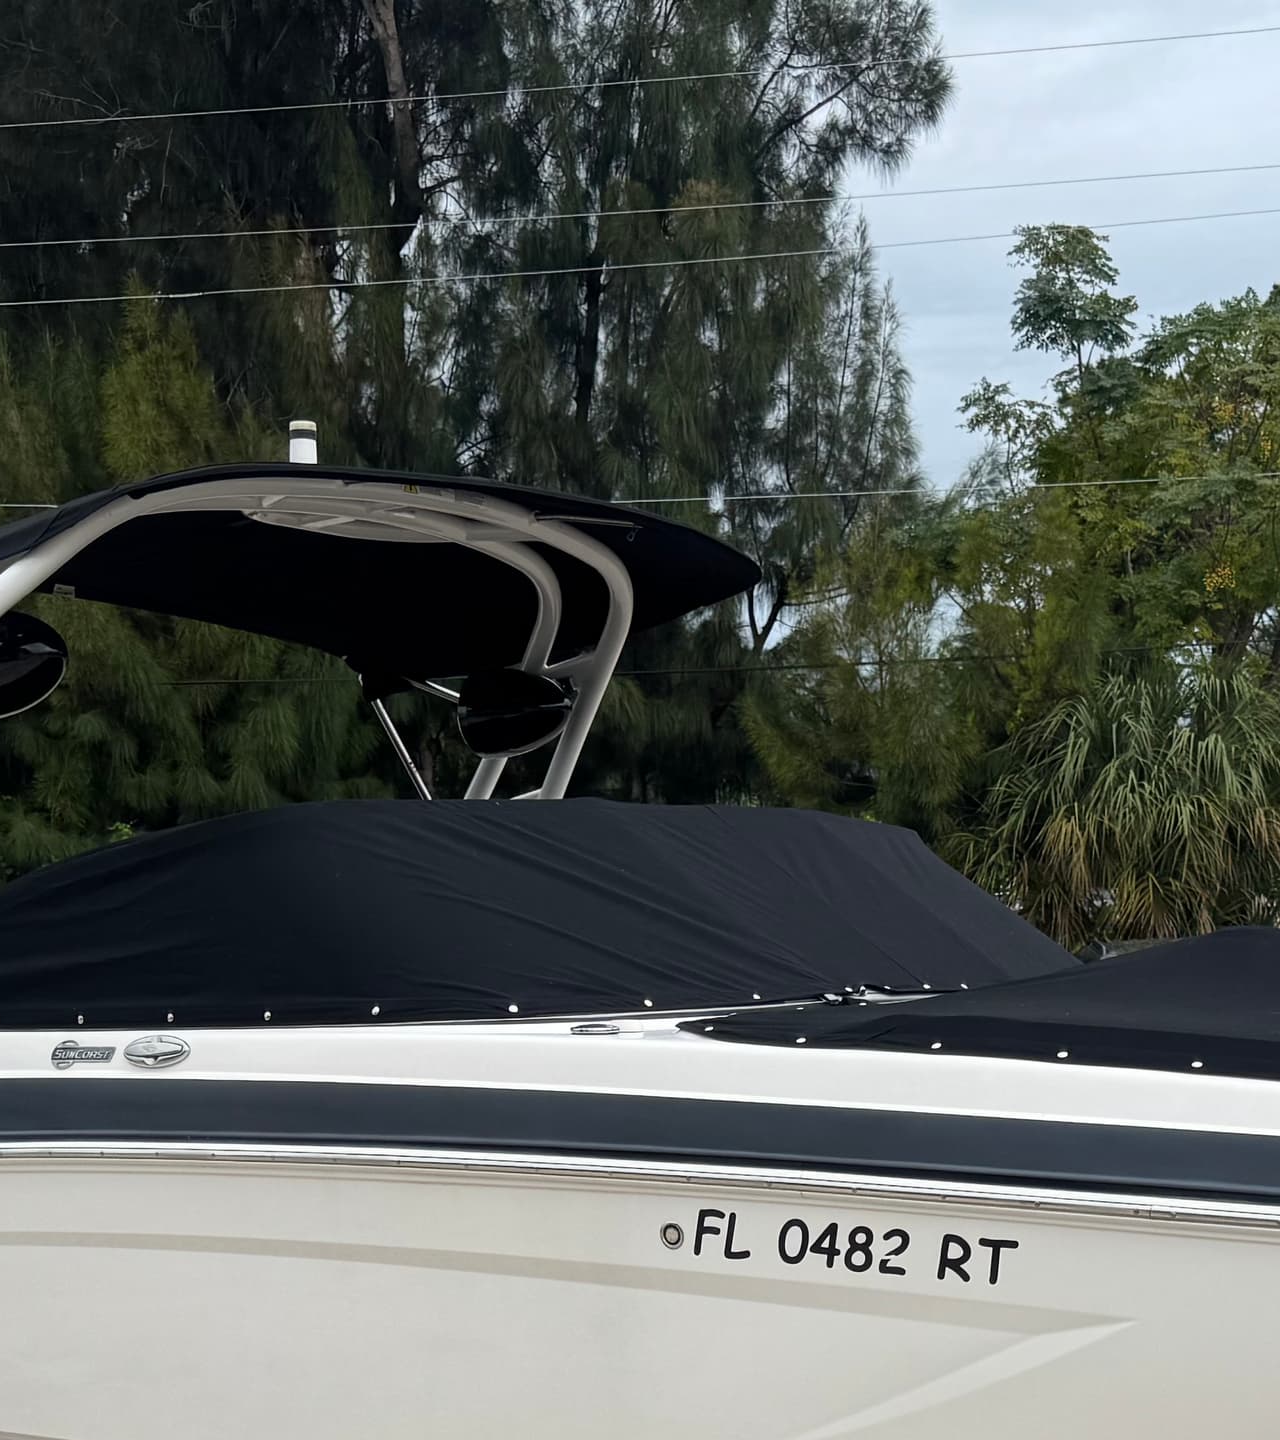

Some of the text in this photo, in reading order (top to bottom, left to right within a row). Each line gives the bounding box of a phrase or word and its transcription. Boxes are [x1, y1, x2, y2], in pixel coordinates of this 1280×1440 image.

[693, 1208, 1020, 1285] FL 0482 RT
